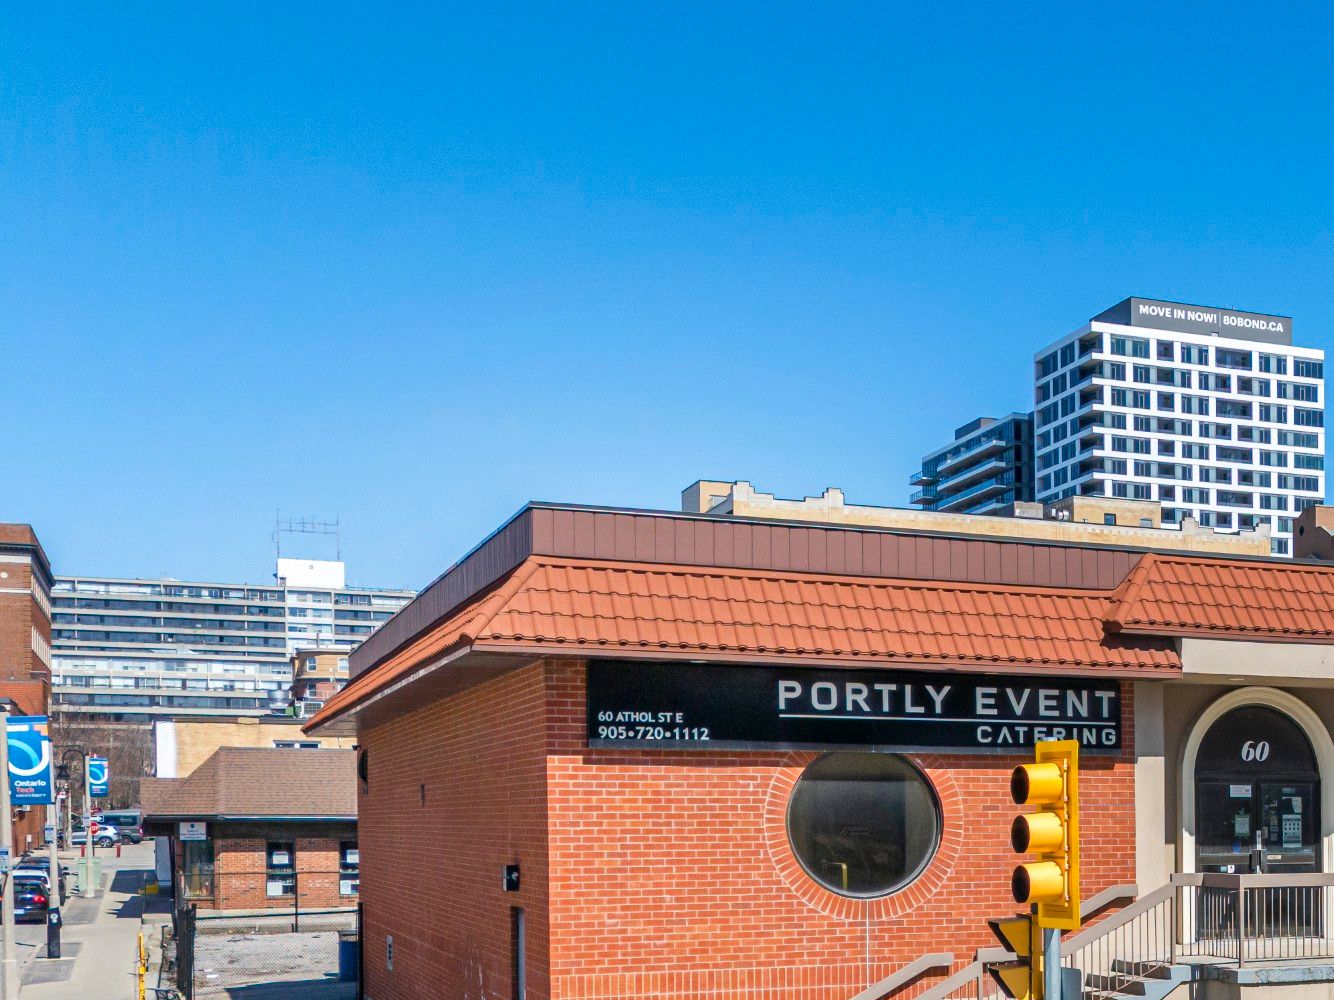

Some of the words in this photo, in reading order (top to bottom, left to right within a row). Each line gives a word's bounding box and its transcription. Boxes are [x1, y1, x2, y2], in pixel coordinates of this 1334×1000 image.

[1139, 304, 1171, 318] MOVE
[1174, 308, 1185, 319] IN
[1187, 311, 1217, 324] NOW!
[1223, 315, 1284, 333] 80BOND.CA
[778, 680, 951, 714] PORTLY
[975, 686, 1116, 719] EVENT
[598, 711, 613, 722] 60
[616, 711, 655, 723] ATHOL
[658, 712, 673, 723] ST
[676, 712, 684, 723] E
[976, 725, 1117, 746] CATERING
[1241, 740, 1270, 762] 60
